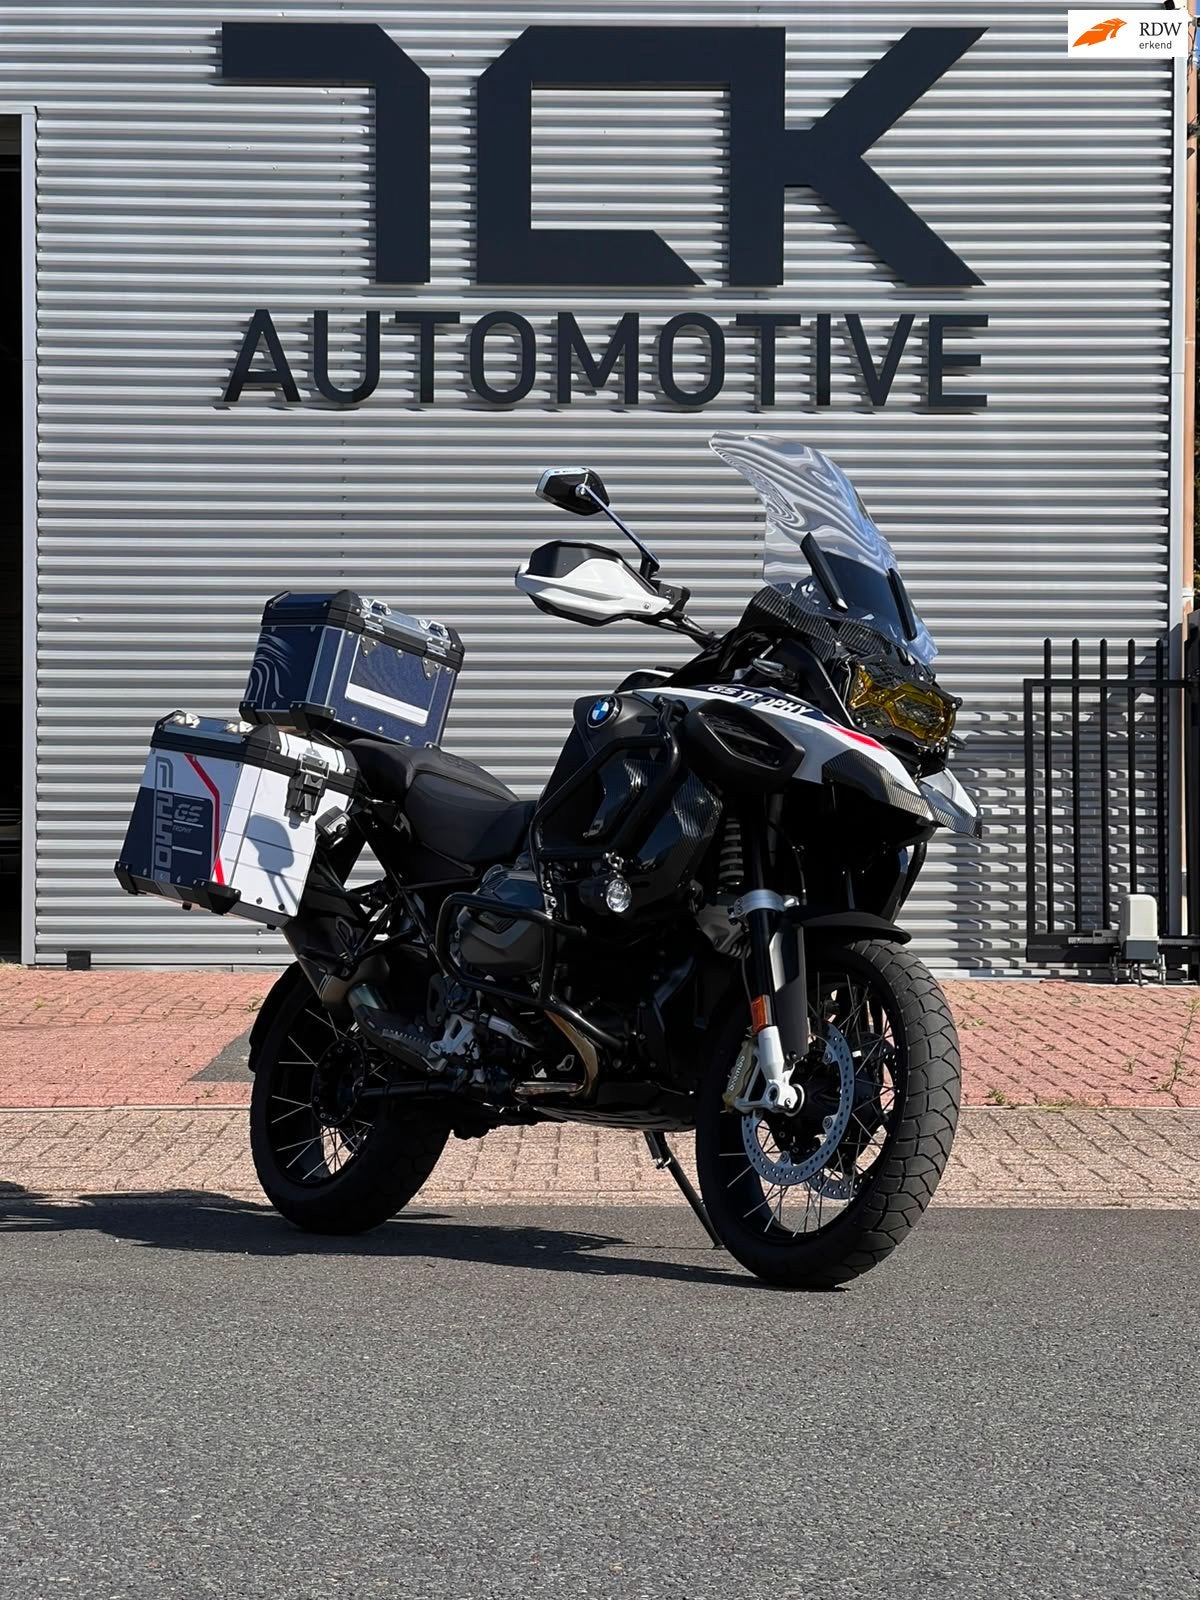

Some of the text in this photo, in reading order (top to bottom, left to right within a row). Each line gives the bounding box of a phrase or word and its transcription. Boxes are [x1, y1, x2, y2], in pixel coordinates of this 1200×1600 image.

[222, 23, 990, 286] TCK
[224, 309, 989, 408] AUTOMOTIVE
[708, 685, 814, 715] GS TROPHY
[174, 803, 204, 822] GS
